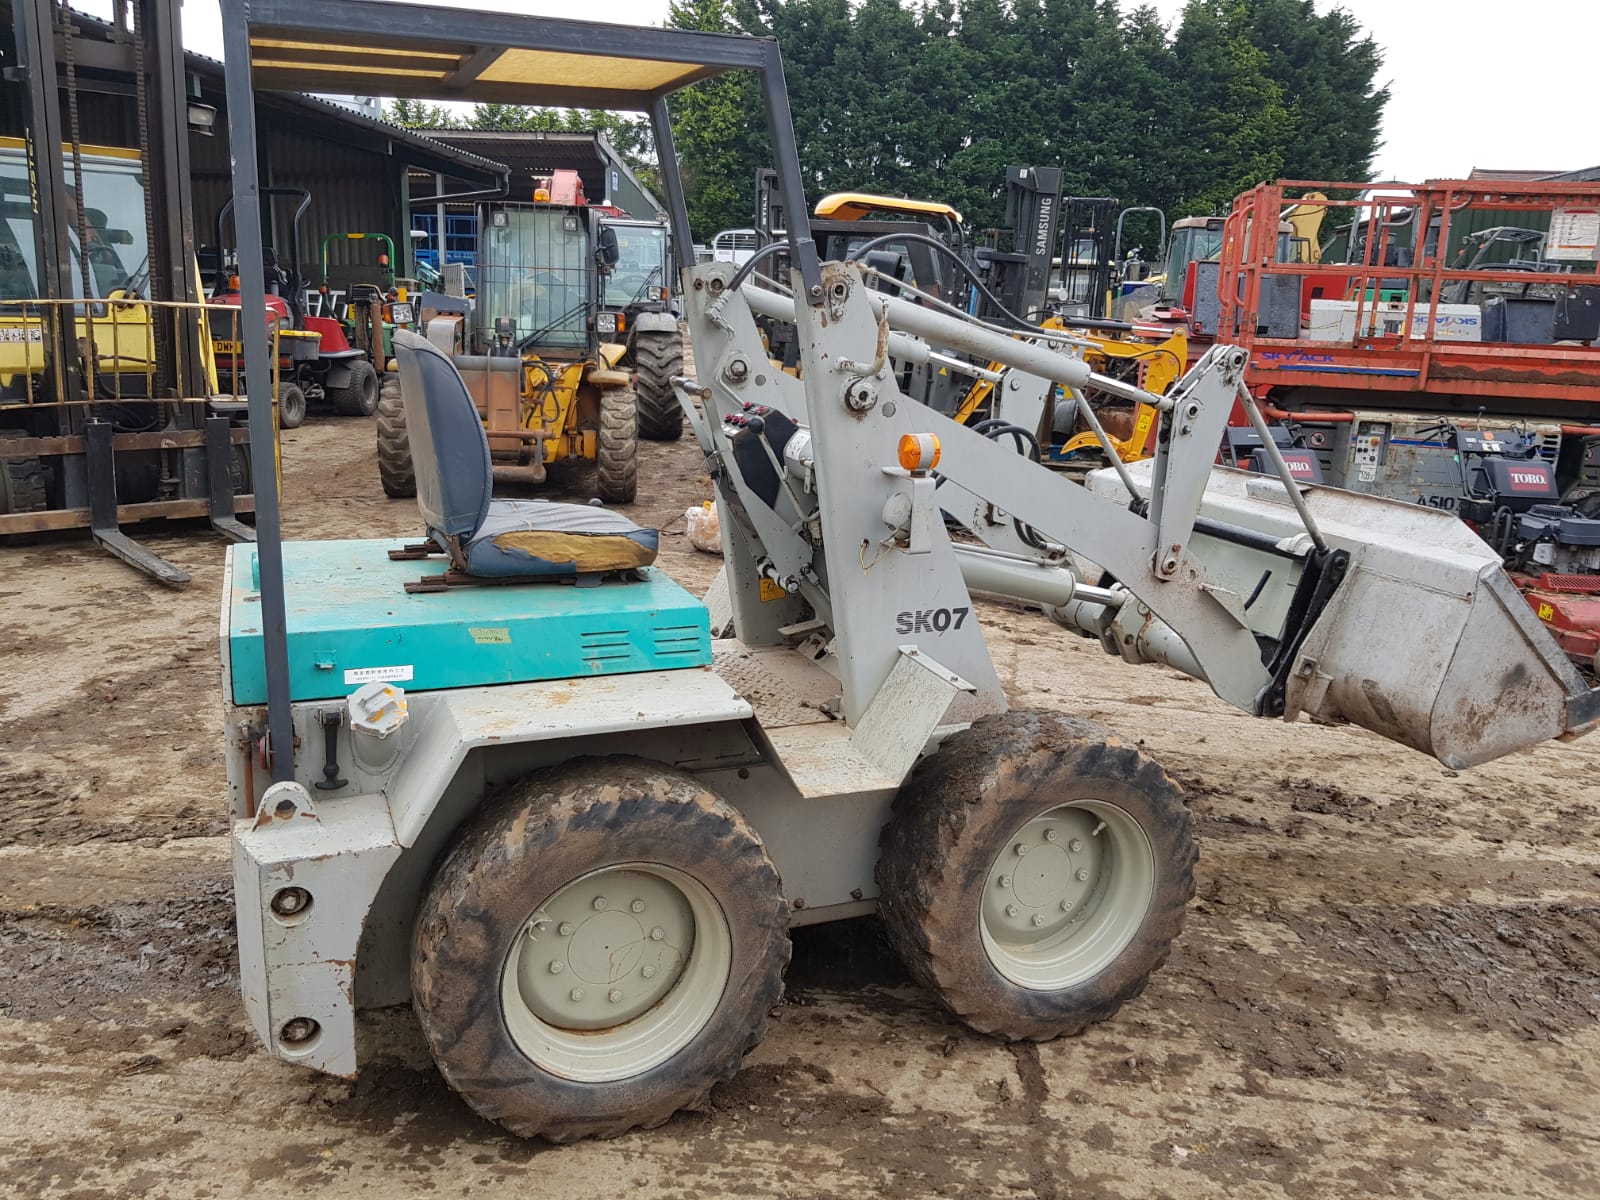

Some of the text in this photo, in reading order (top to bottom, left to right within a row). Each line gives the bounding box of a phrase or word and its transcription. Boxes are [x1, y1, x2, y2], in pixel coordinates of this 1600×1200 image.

[1035, 197, 1052, 256] SAMSUNG
[1286, 461, 1311, 472] ORO.
[895, 606, 969, 636] SK07
